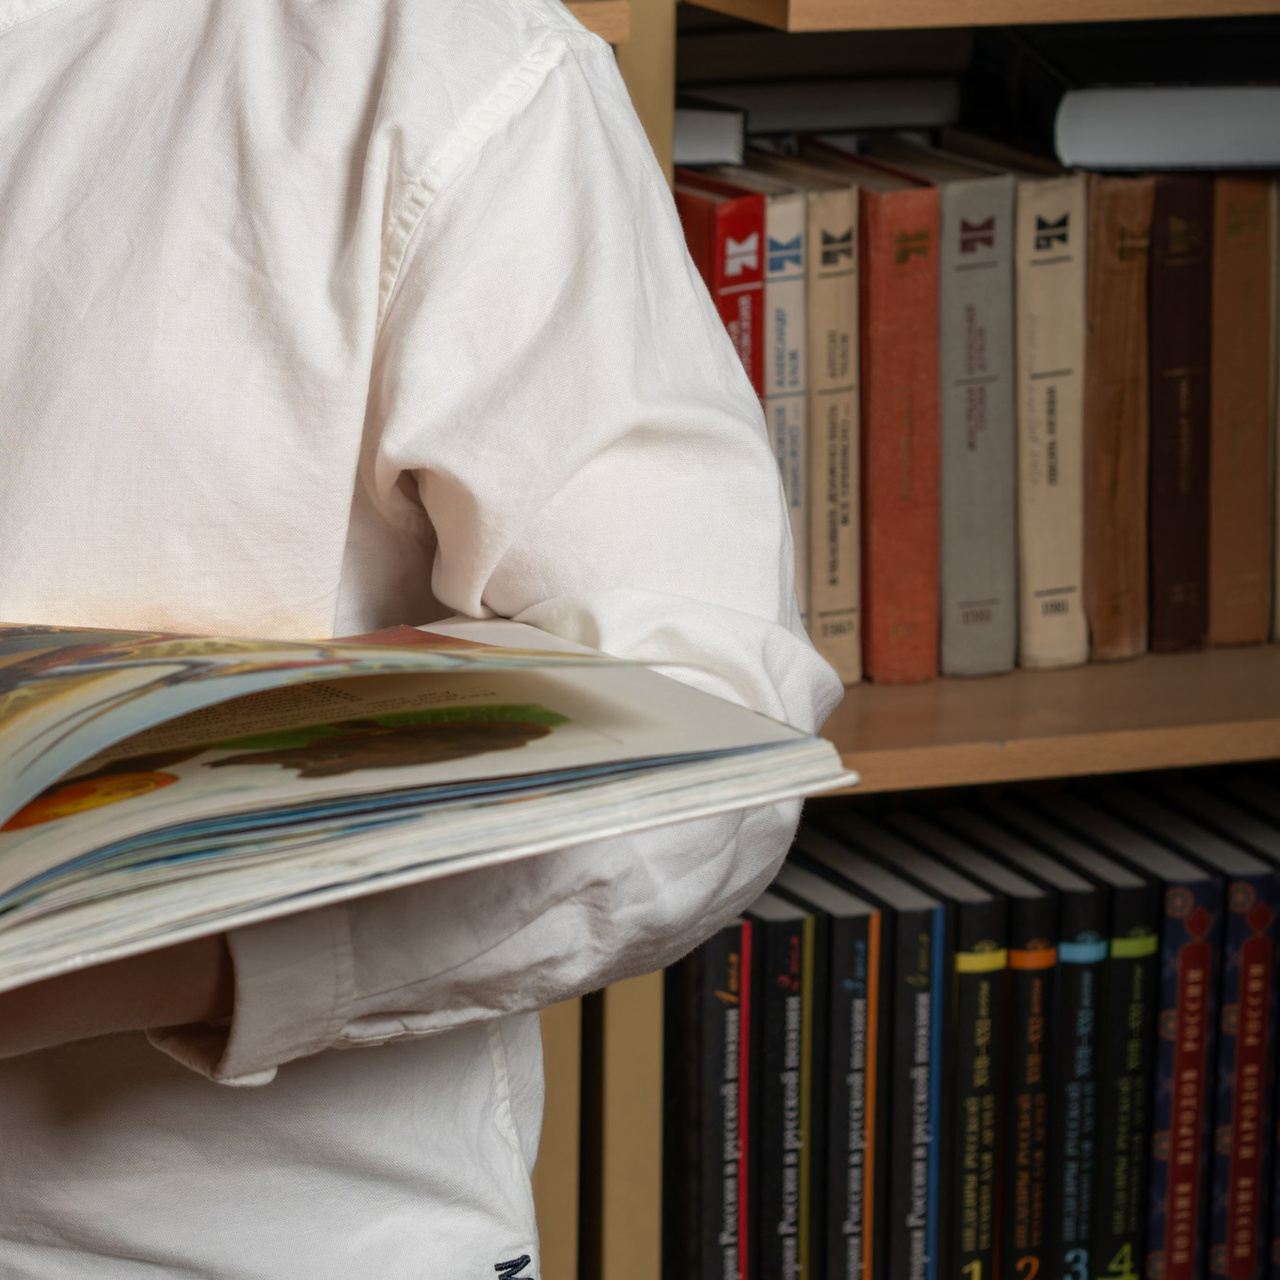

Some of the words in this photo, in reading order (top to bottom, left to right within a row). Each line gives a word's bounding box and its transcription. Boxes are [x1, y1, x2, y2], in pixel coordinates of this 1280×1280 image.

[1182, 968, 1204, 1052] РОССИИ
[1244, 963, 1266, 1047] РОССИИ
[719, 1082, 743, 1162] русской
[780, 1070, 804, 1151] русской
[845, 1073, 868, 1150] русской
[909, 1065, 932, 1145] русской
[1176, 1068, 1199, 1166] НАРОДОВ
[1238, 1063, 1260, 1160] НАРОДОВ
[718, 1175, 738, 1245] России
[776, 1165, 798, 1235] России
[841, 1166, 863, 1234] России
[905, 1158, 927, 1228] России
[1107, 1242, 1134, 1278] 4
